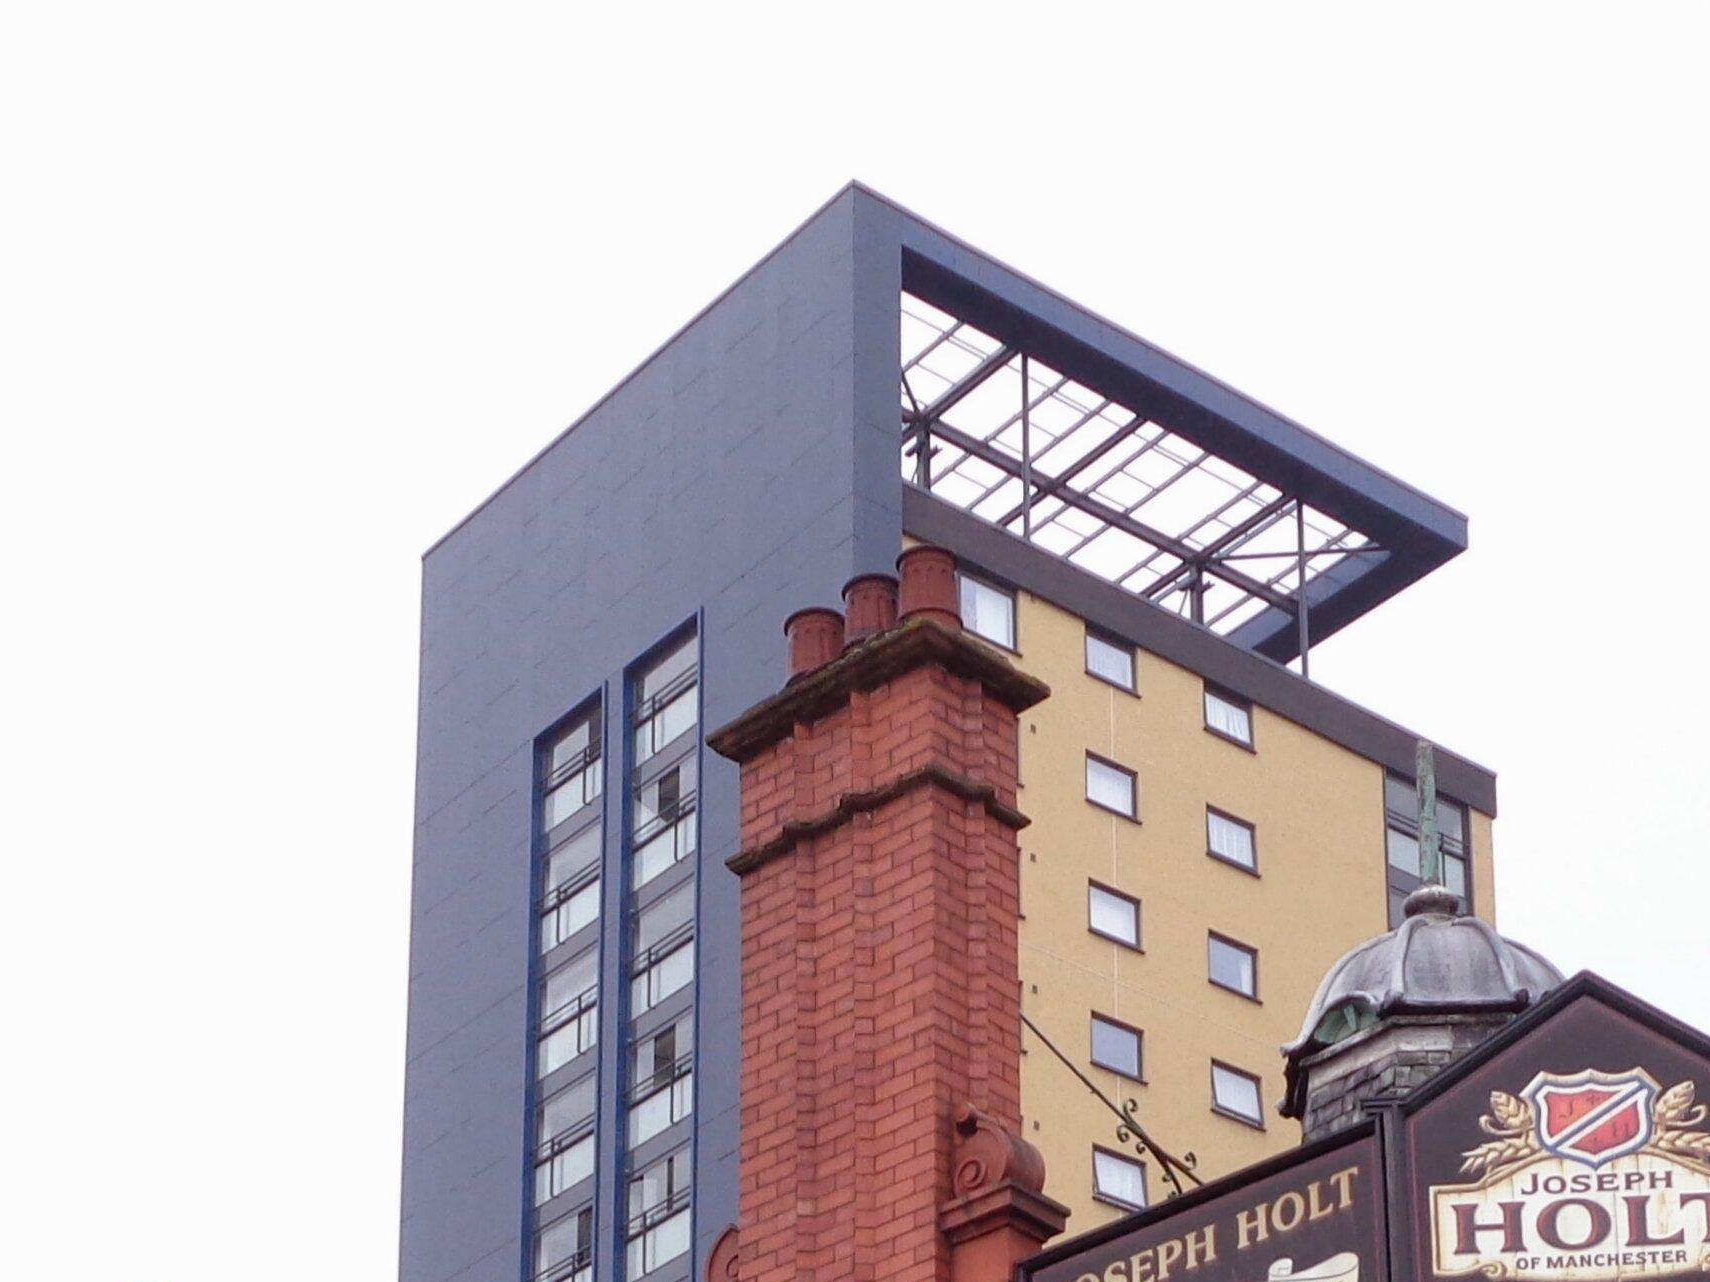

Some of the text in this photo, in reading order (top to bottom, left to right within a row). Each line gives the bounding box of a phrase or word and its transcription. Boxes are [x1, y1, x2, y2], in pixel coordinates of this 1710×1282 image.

[1521, 1171, 1673, 1196] JOSEPH
[1236, 1166, 1359, 1253] HOLT
[1516, 1250, 1687, 1270] OF MANCHESTER
